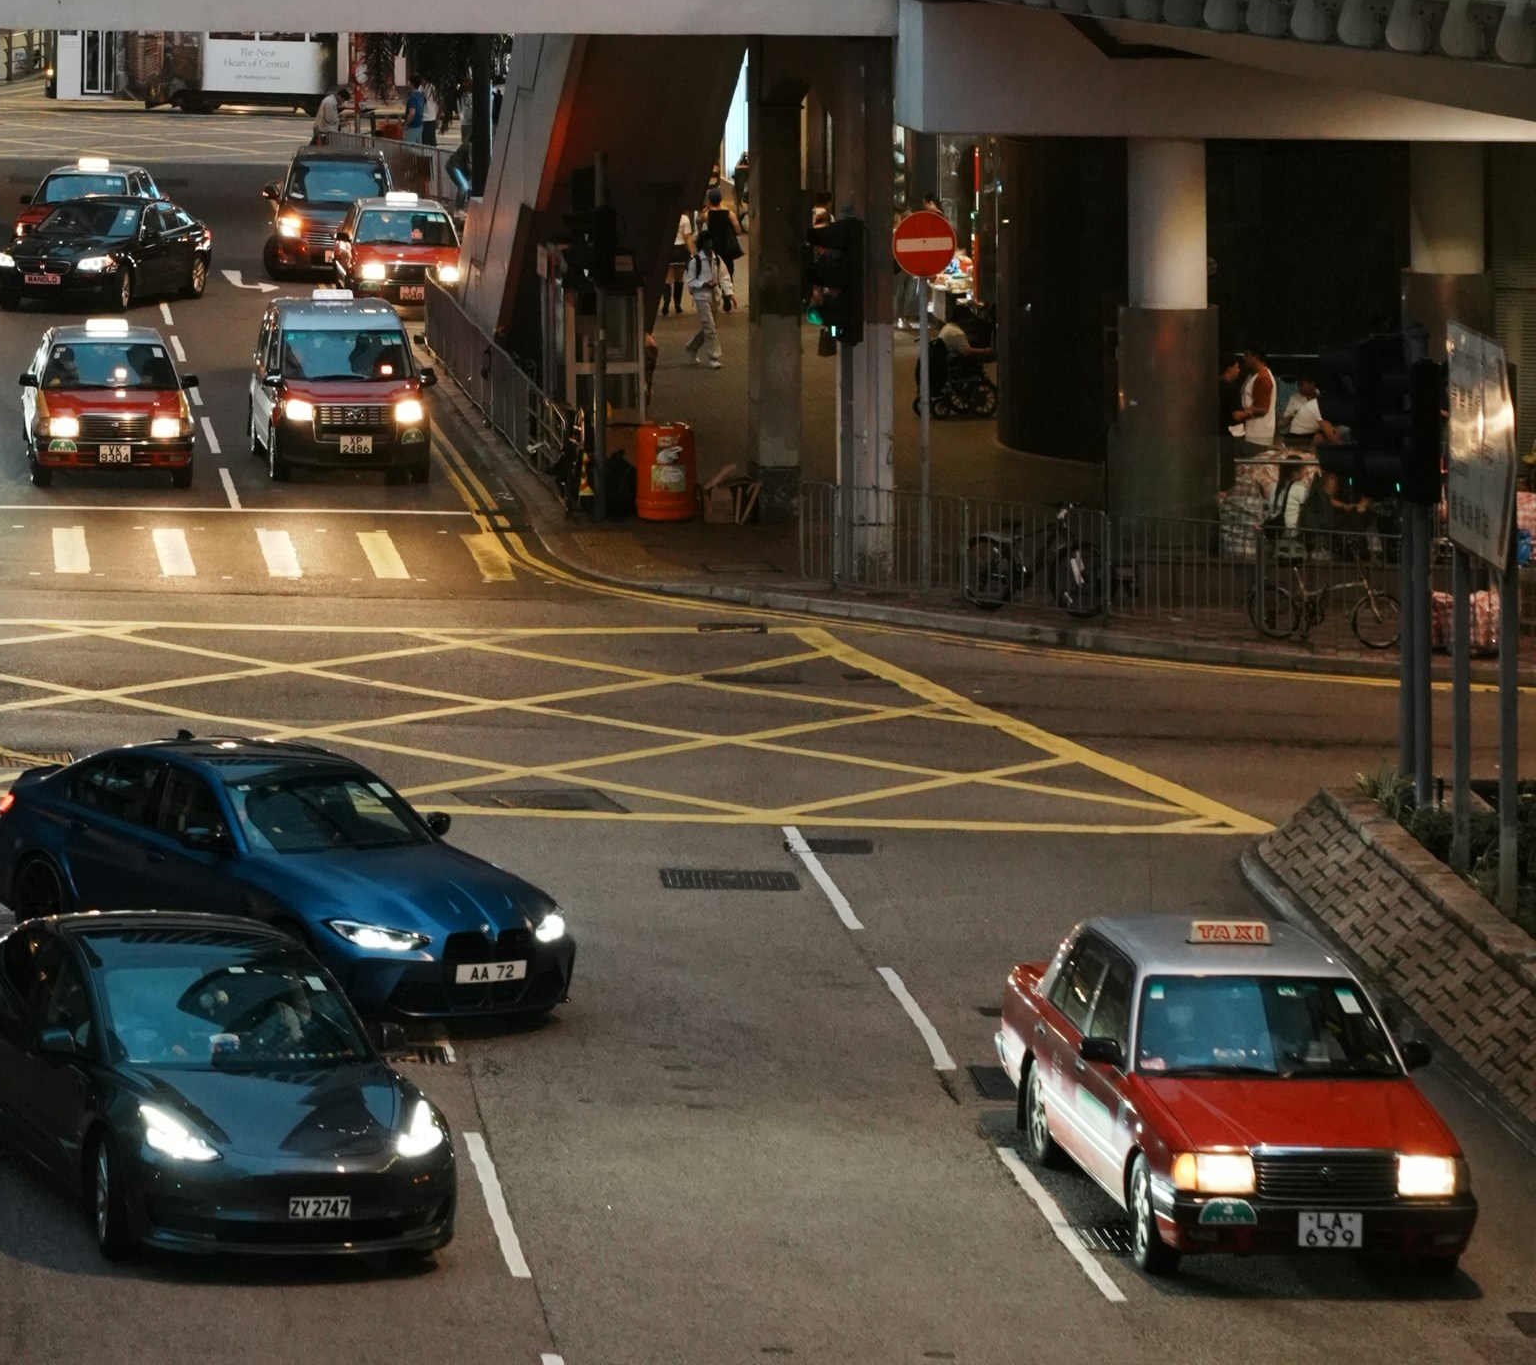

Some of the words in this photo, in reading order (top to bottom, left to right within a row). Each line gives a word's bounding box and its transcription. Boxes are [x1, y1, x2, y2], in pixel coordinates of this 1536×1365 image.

[257, 49, 276, 57] New
[224, 58, 245, 66] Heart
[259, 59, 290, 68] Central
[350, 436, 363, 445] XP
[108, 445, 122, 454] VK
[342, 445, 370, 453] 2486
[101, 453, 129, 462] 9304
[1199, 925, 1264, 940] TAXI
[470, 966, 489, 980] AA
[497, 964, 514, 979] 72
[291, 1200, 310, 1217] ZY
[312, 1199, 349, 1217] 2747
[1223, 1204, 1234, 1216] 4
[1317, 1213, 1343, 1229] LA
[1306, 1229, 1355, 1246] 699
